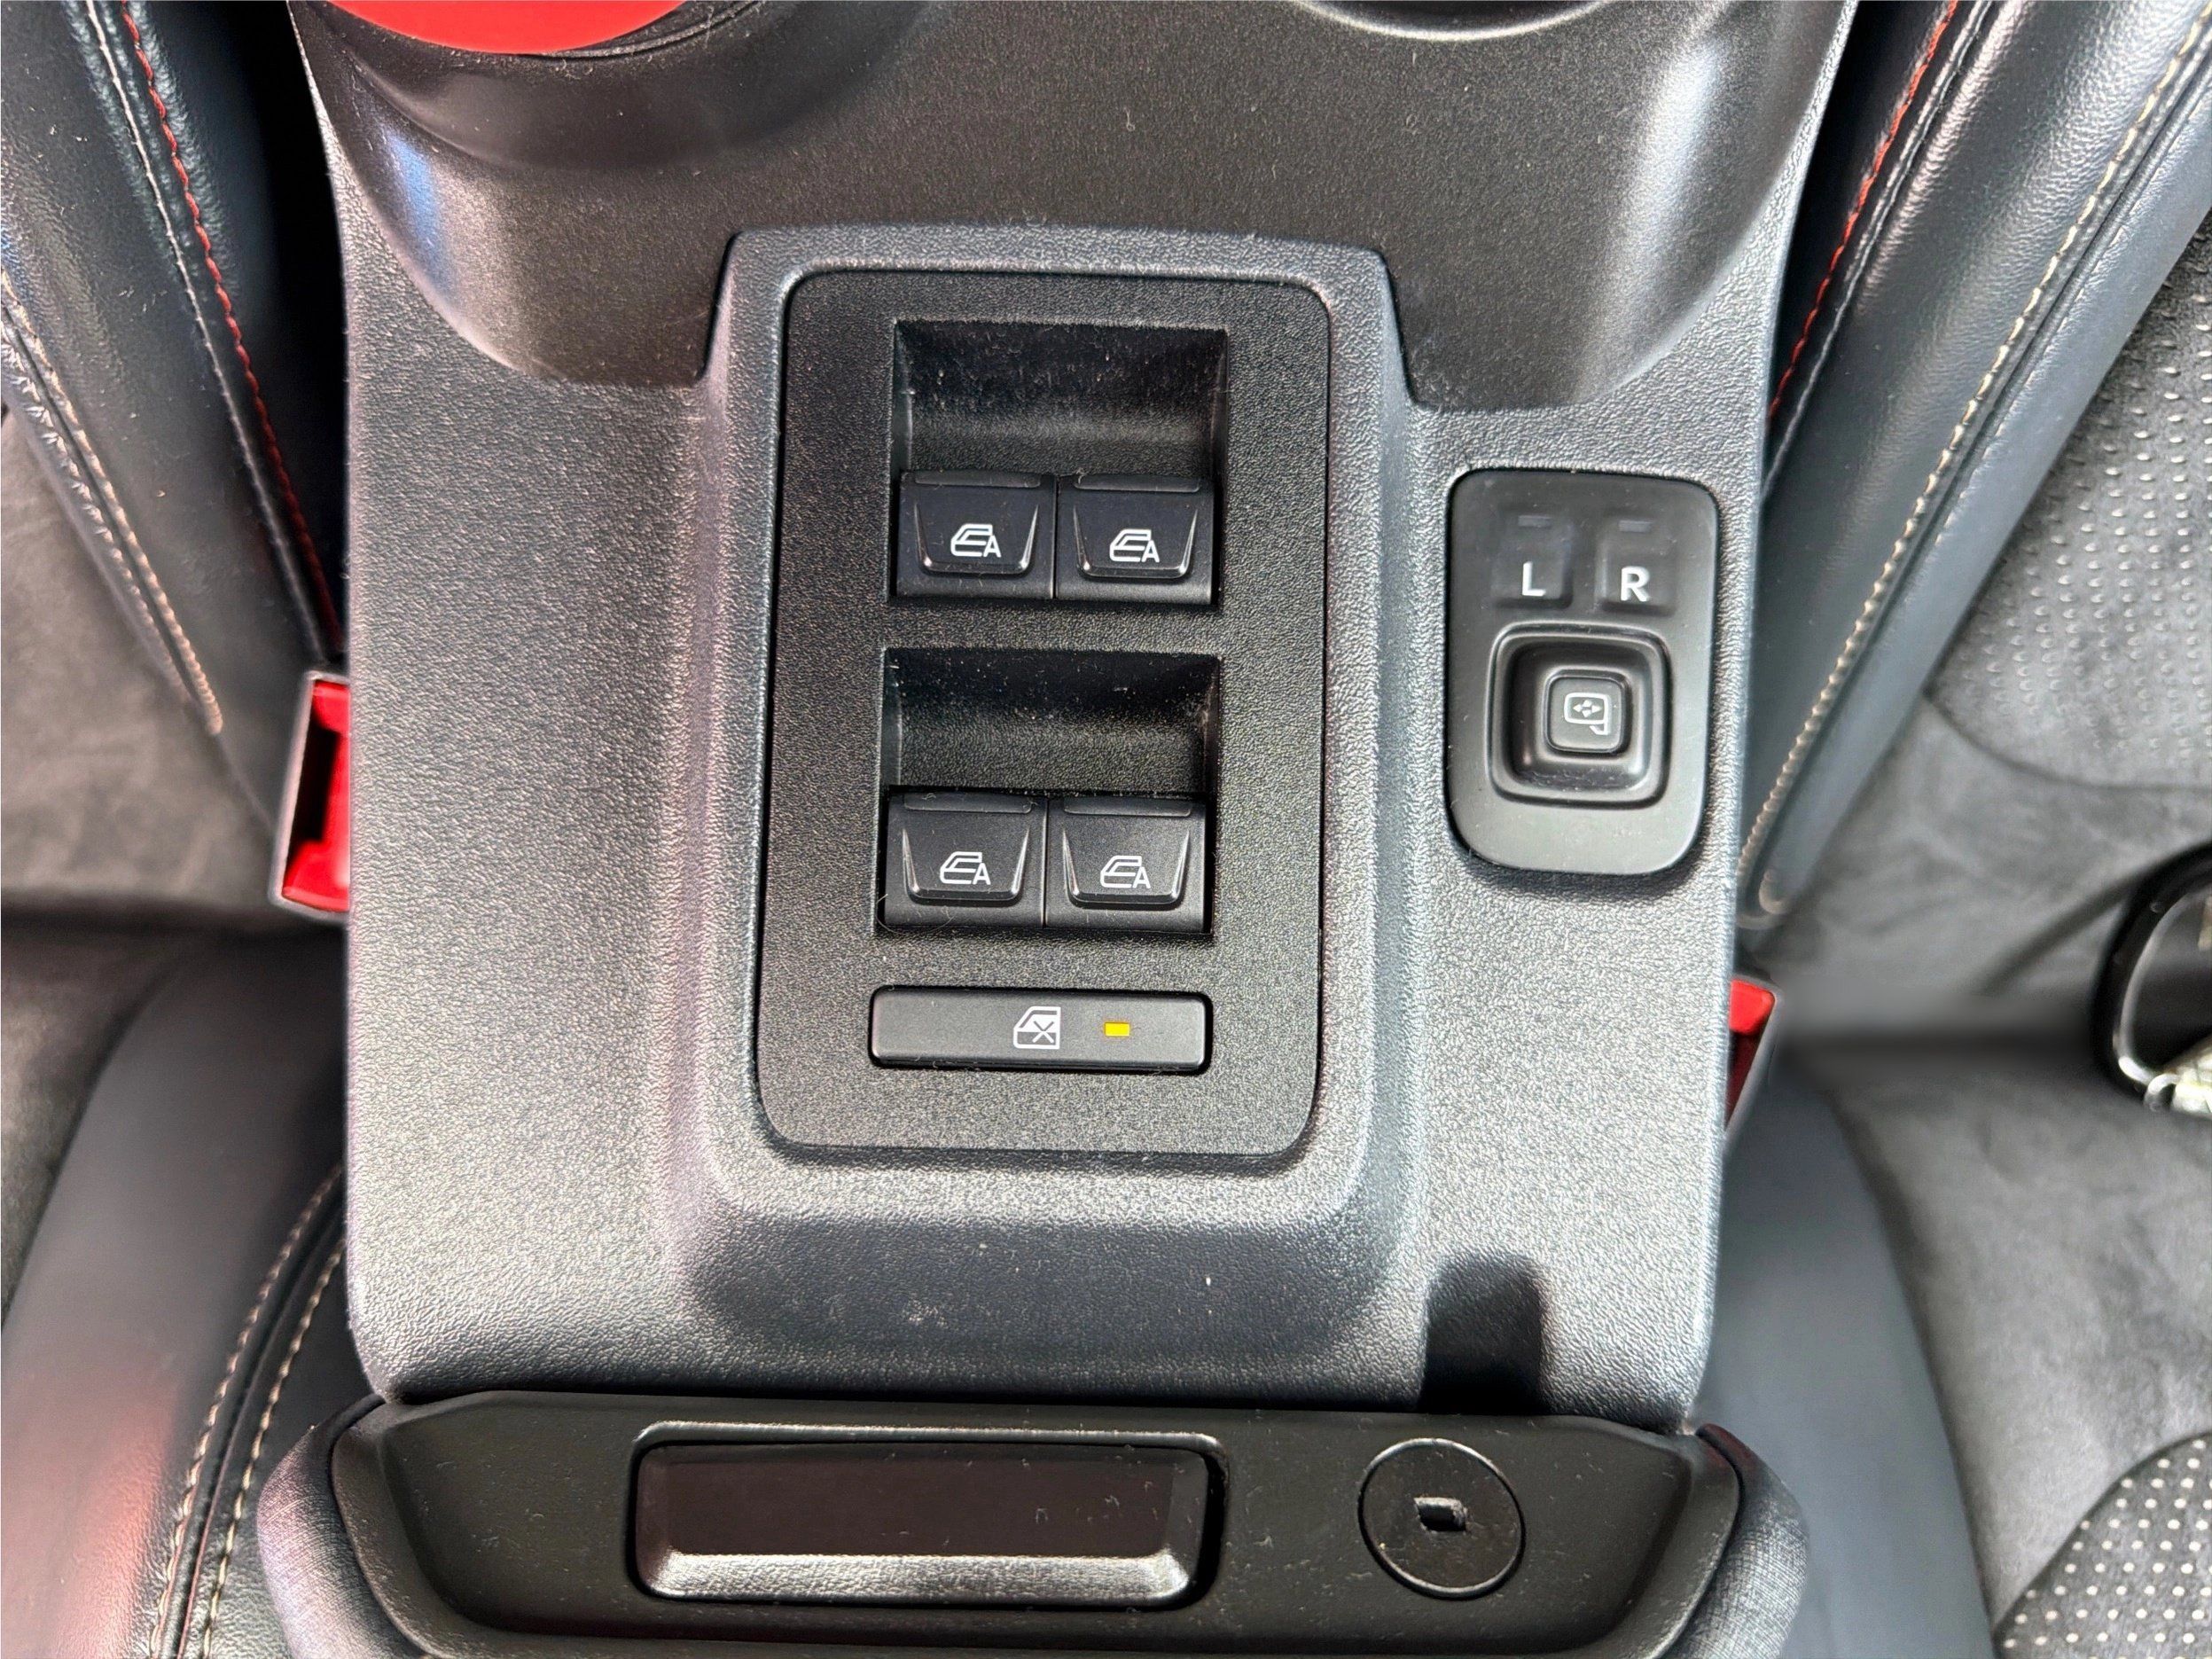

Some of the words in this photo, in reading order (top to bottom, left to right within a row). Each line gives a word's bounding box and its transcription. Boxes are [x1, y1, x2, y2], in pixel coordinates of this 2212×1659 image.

[982, 536, 1002, 558] A
[1141, 540, 1160, 563] A
[1521, 561, 1546, 596] L
[1621, 566, 1650, 602] R
[972, 863, 991, 885] A
[1132, 866, 1151, 888] A
